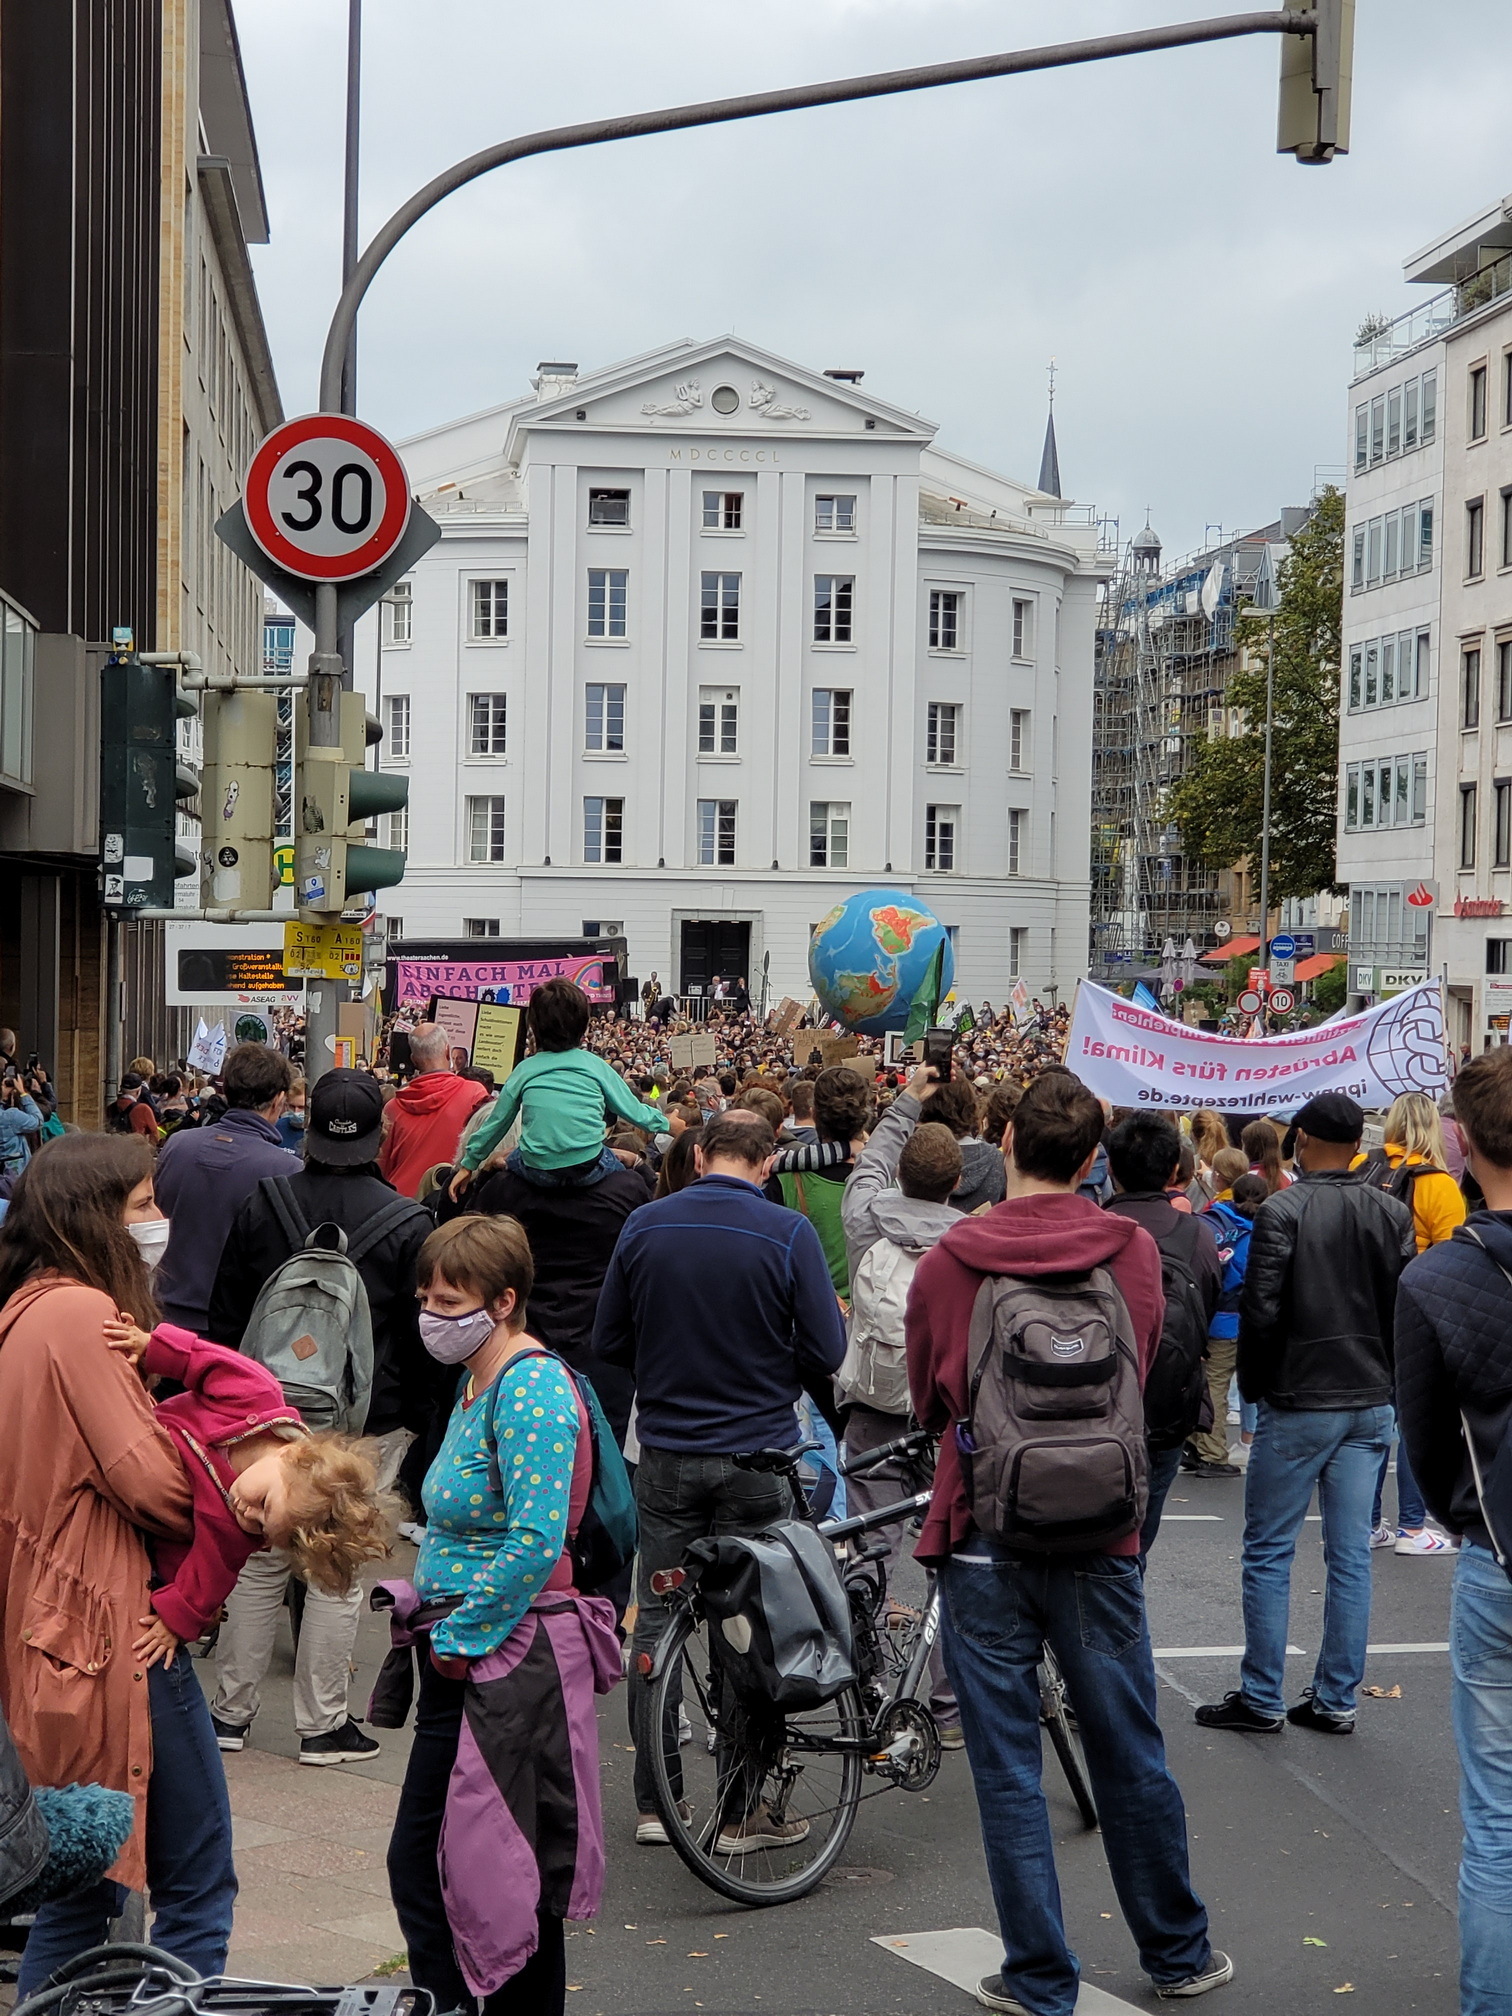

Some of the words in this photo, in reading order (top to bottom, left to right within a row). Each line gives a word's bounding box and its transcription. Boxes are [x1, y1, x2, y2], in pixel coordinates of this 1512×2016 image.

[670, 448, 780, 463] MDCCCCL
[281, 460, 373, 535] 30
[278, 854, 295, 878] H
[296, 931, 304, 942] S
[334, 933, 343, 944] A
[345, 937, 361, 945] 160
[1331, 934, 1349, 948] COFF
[386, 953, 449, 961] www.theateraachen.de
[402, 965, 506, 982] EINFACH
[517, 962, 566, 980] MAL
[1358, 973, 1372, 986] DKV
[1385, 975, 1423, 986] DKV
[250, 995, 276, 1003] ASEAG
[1275, 995, 1288, 1007] 10
[915, 1490, 934, 1507] SX
[924, 1595, 940, 1646] GU
